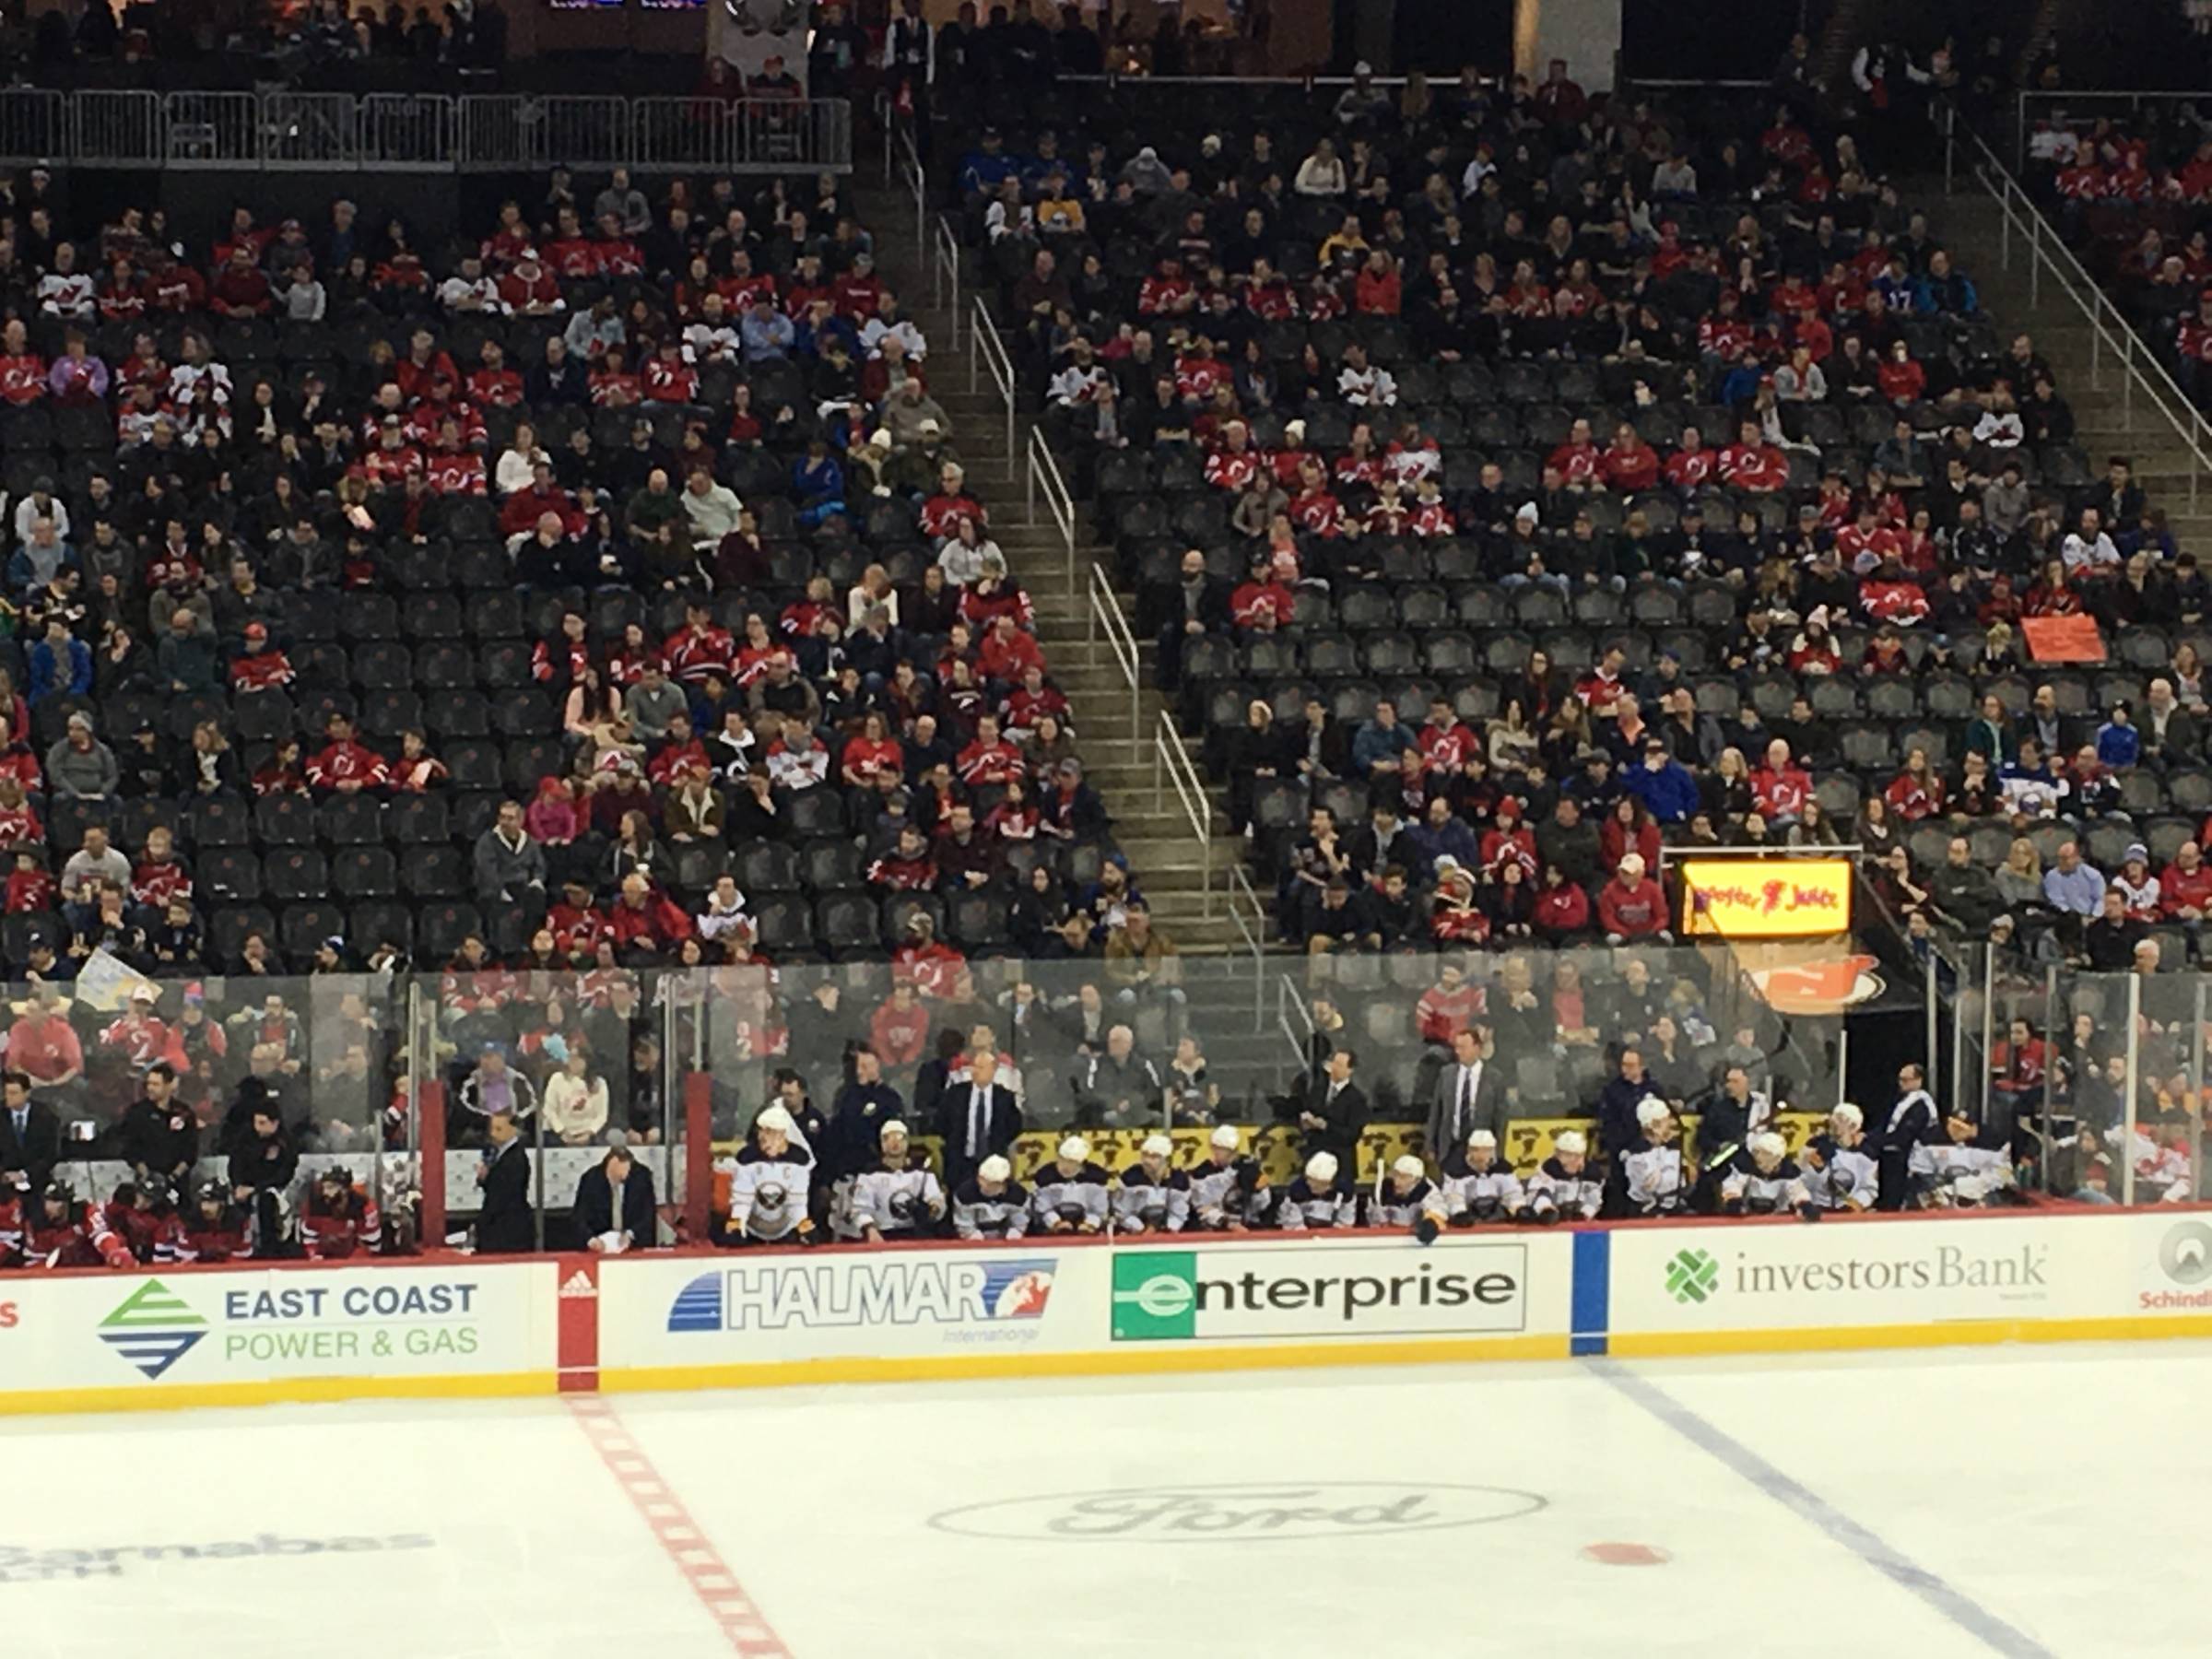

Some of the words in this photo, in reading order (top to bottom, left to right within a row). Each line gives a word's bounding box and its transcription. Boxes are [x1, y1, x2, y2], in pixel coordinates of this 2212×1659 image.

[226, 1289, 328, 1319] EAST
[343, 1285, 477, 1316] COAST
[727, 1262, 987, 1329] HALMAR
[1112, 1263, 1516, 1319] enterprise
[226, 1331, 359, 1360] POWER
[372, 1330, 393, 1356] &
[406, 1328, 477, 1354] GAS
[1048, 1489, 1440, 1534] Ford
